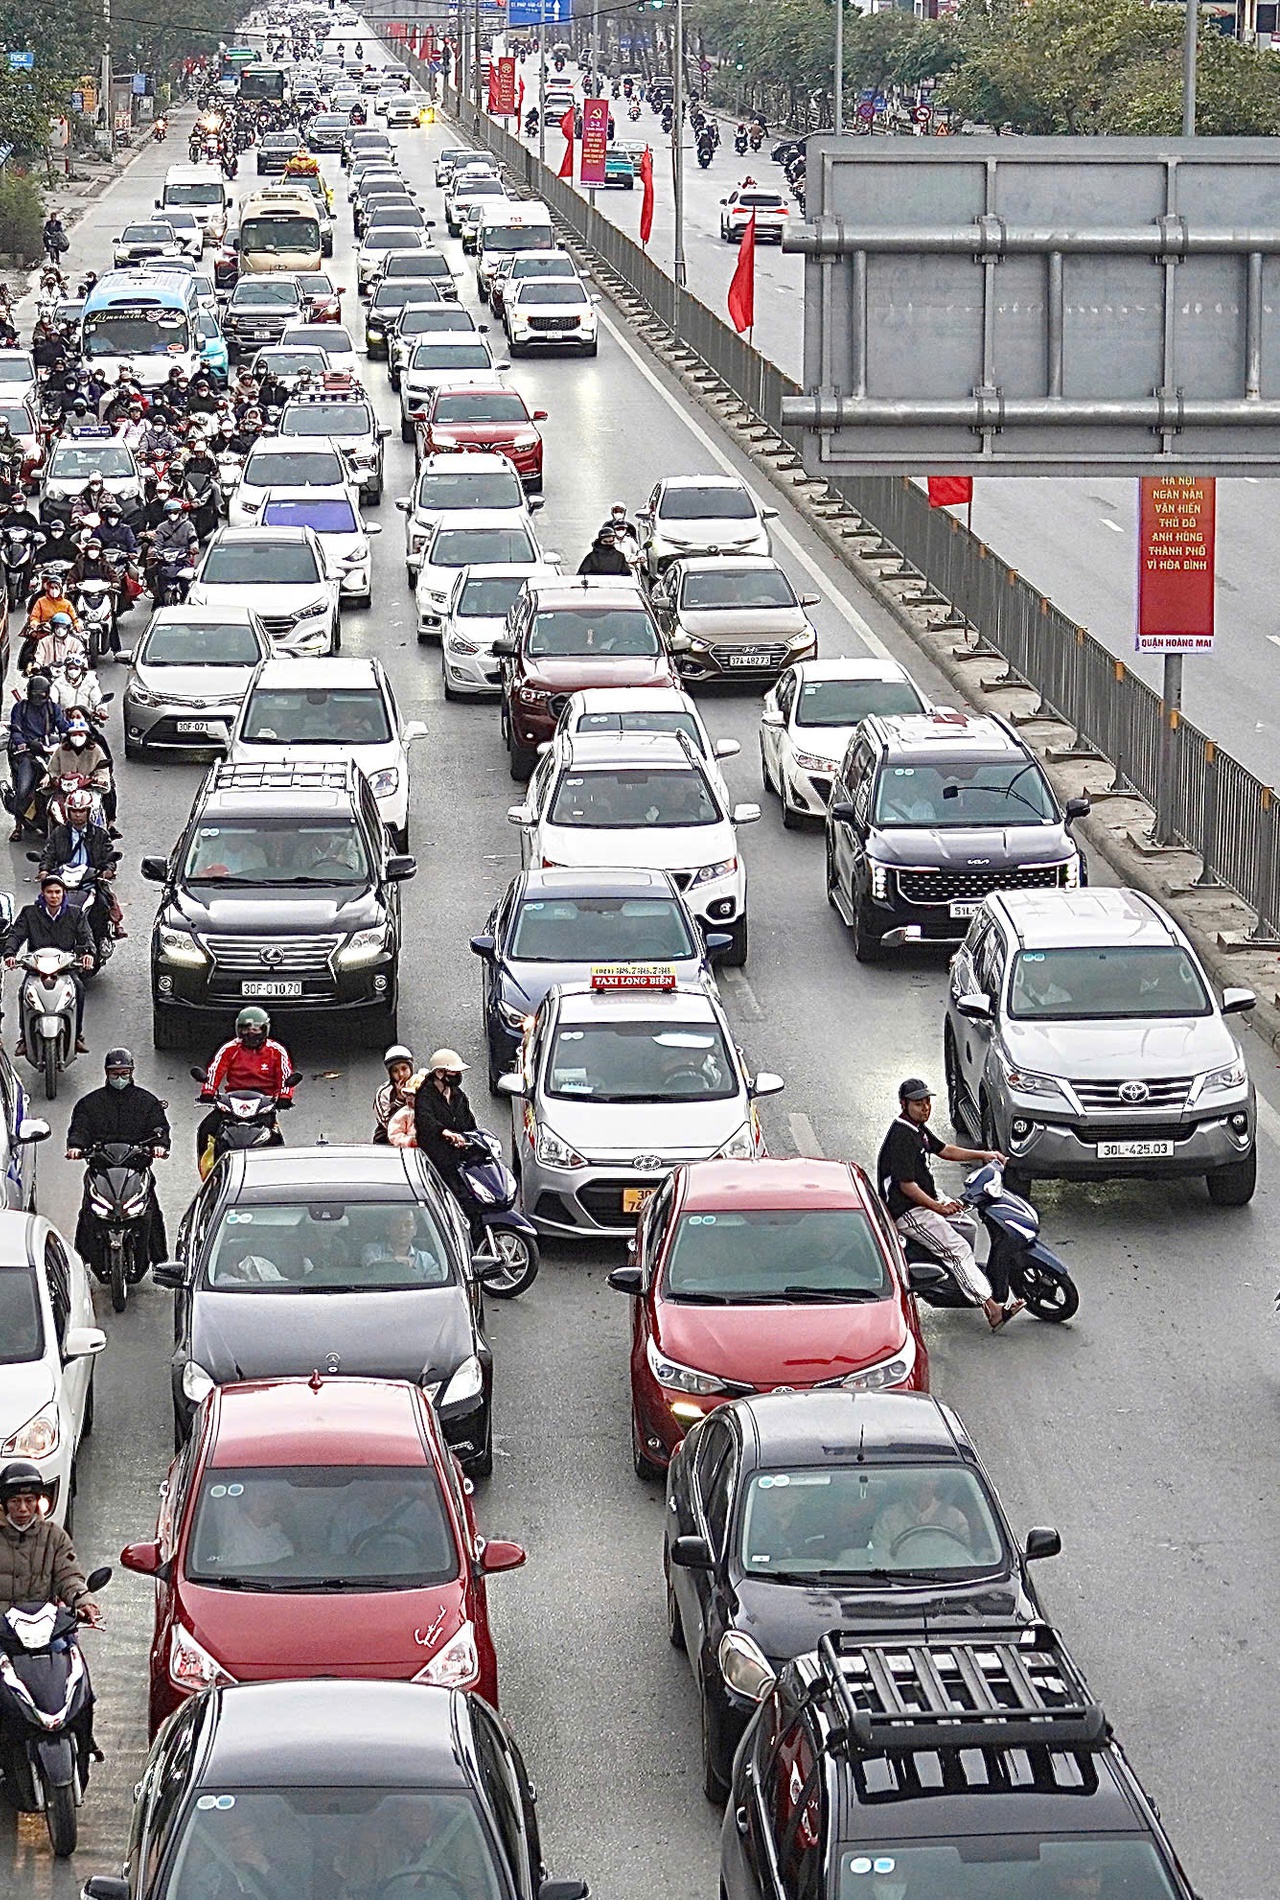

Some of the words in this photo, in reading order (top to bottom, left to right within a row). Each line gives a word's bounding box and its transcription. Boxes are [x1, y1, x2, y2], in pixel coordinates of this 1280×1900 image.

[1152, 532, 1173, 542] ANH
[1141, 637, 1164, 649] QUẬN
[1166, 637, 1194, 648] HOÀNG
[1196, 638, 1212, 648] MAI
[595, 977, 618, 985] TAXI
[620, 977, 648, 985] LONG
[649, 975, 673, 985] BIÊN
[1103, 1143, 1168, 1156] 30L-425.03
